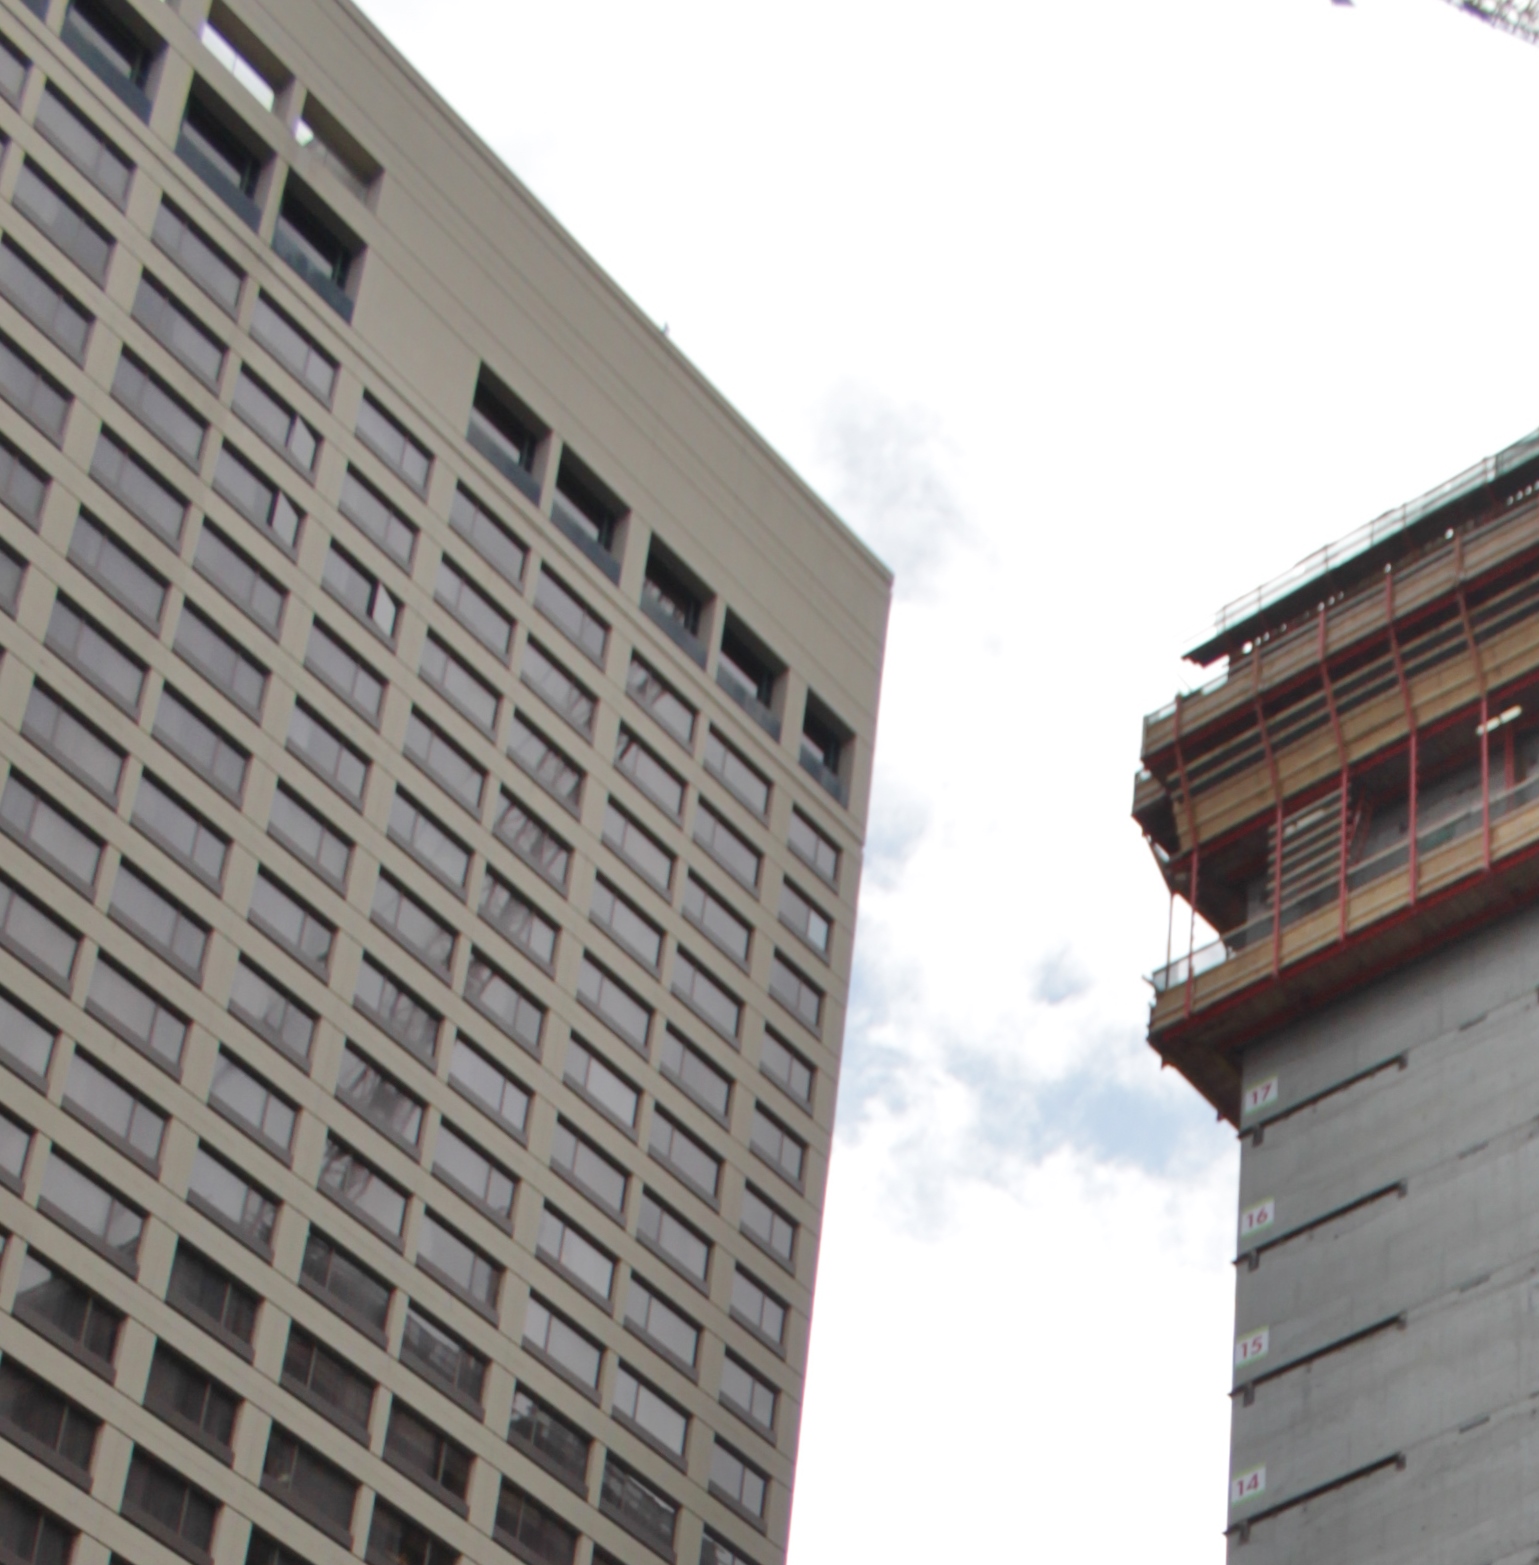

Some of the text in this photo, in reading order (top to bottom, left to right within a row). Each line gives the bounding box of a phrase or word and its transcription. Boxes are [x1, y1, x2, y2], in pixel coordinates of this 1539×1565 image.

[1252, 1083, 1272, 1105] 17
[1248, 1207, 1268, 1227] 16
[1241, 1336, 1261, 1357] 15
[1237, 1473, 1259, 1496] 14
